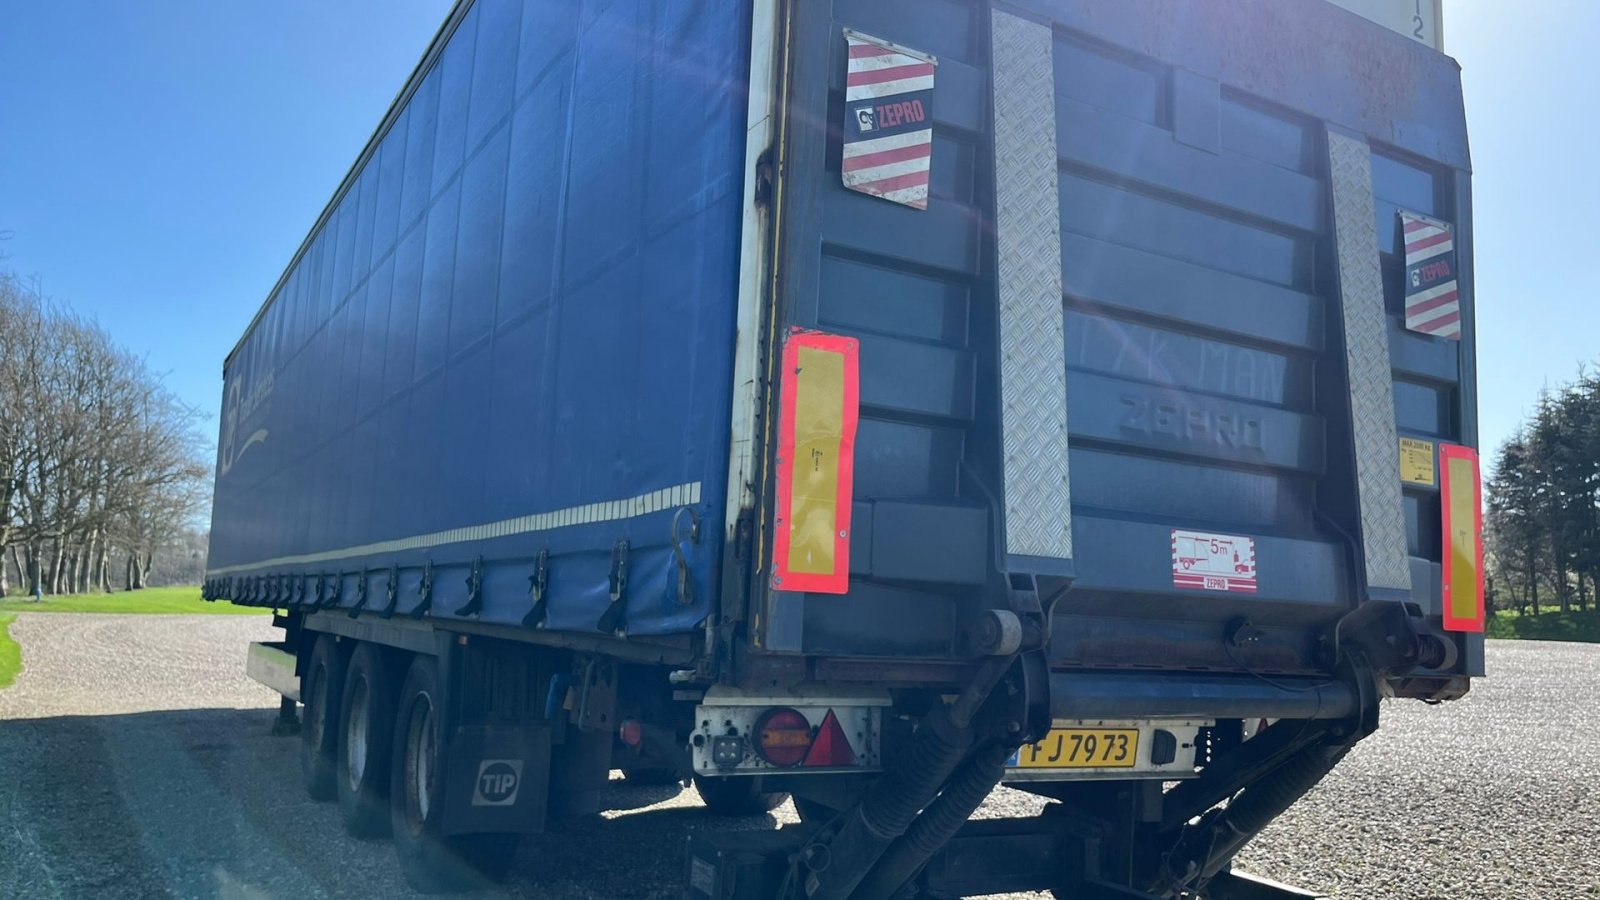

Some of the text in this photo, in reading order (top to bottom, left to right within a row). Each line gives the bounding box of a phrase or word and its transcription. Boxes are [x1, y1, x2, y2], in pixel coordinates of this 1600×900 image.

[876, 99, 925, 128] ZEPRO
[1420, 260, 1450, 282] ZEPRO
[1120, 394, 1265, 453] ZEPRO
[1206, 578, 1226, 590] ZEPRO
[483, 774, 515, 793] TIP
